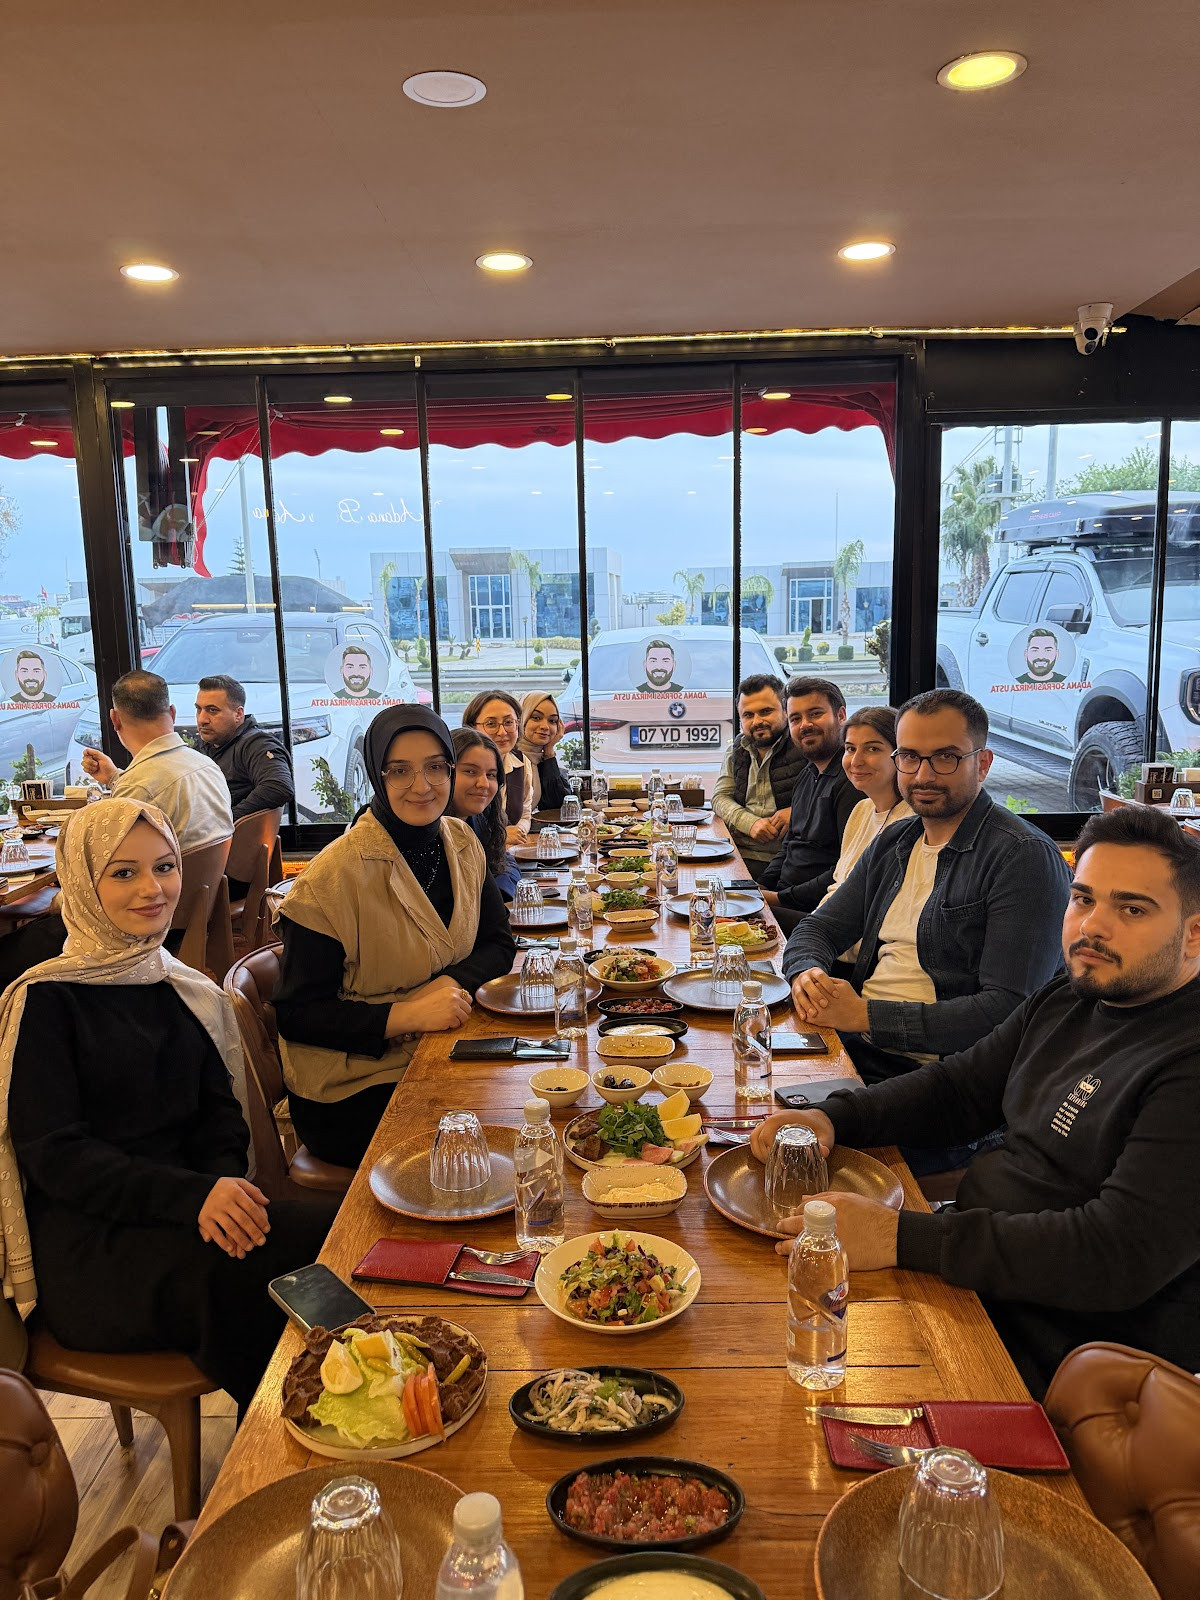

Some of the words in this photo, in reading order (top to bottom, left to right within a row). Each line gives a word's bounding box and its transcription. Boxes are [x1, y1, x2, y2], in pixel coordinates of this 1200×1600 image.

[639, 728, 657, 743] 07
[660, 728, 681, 742] YD
[685, 727, 718, 742] 1992
